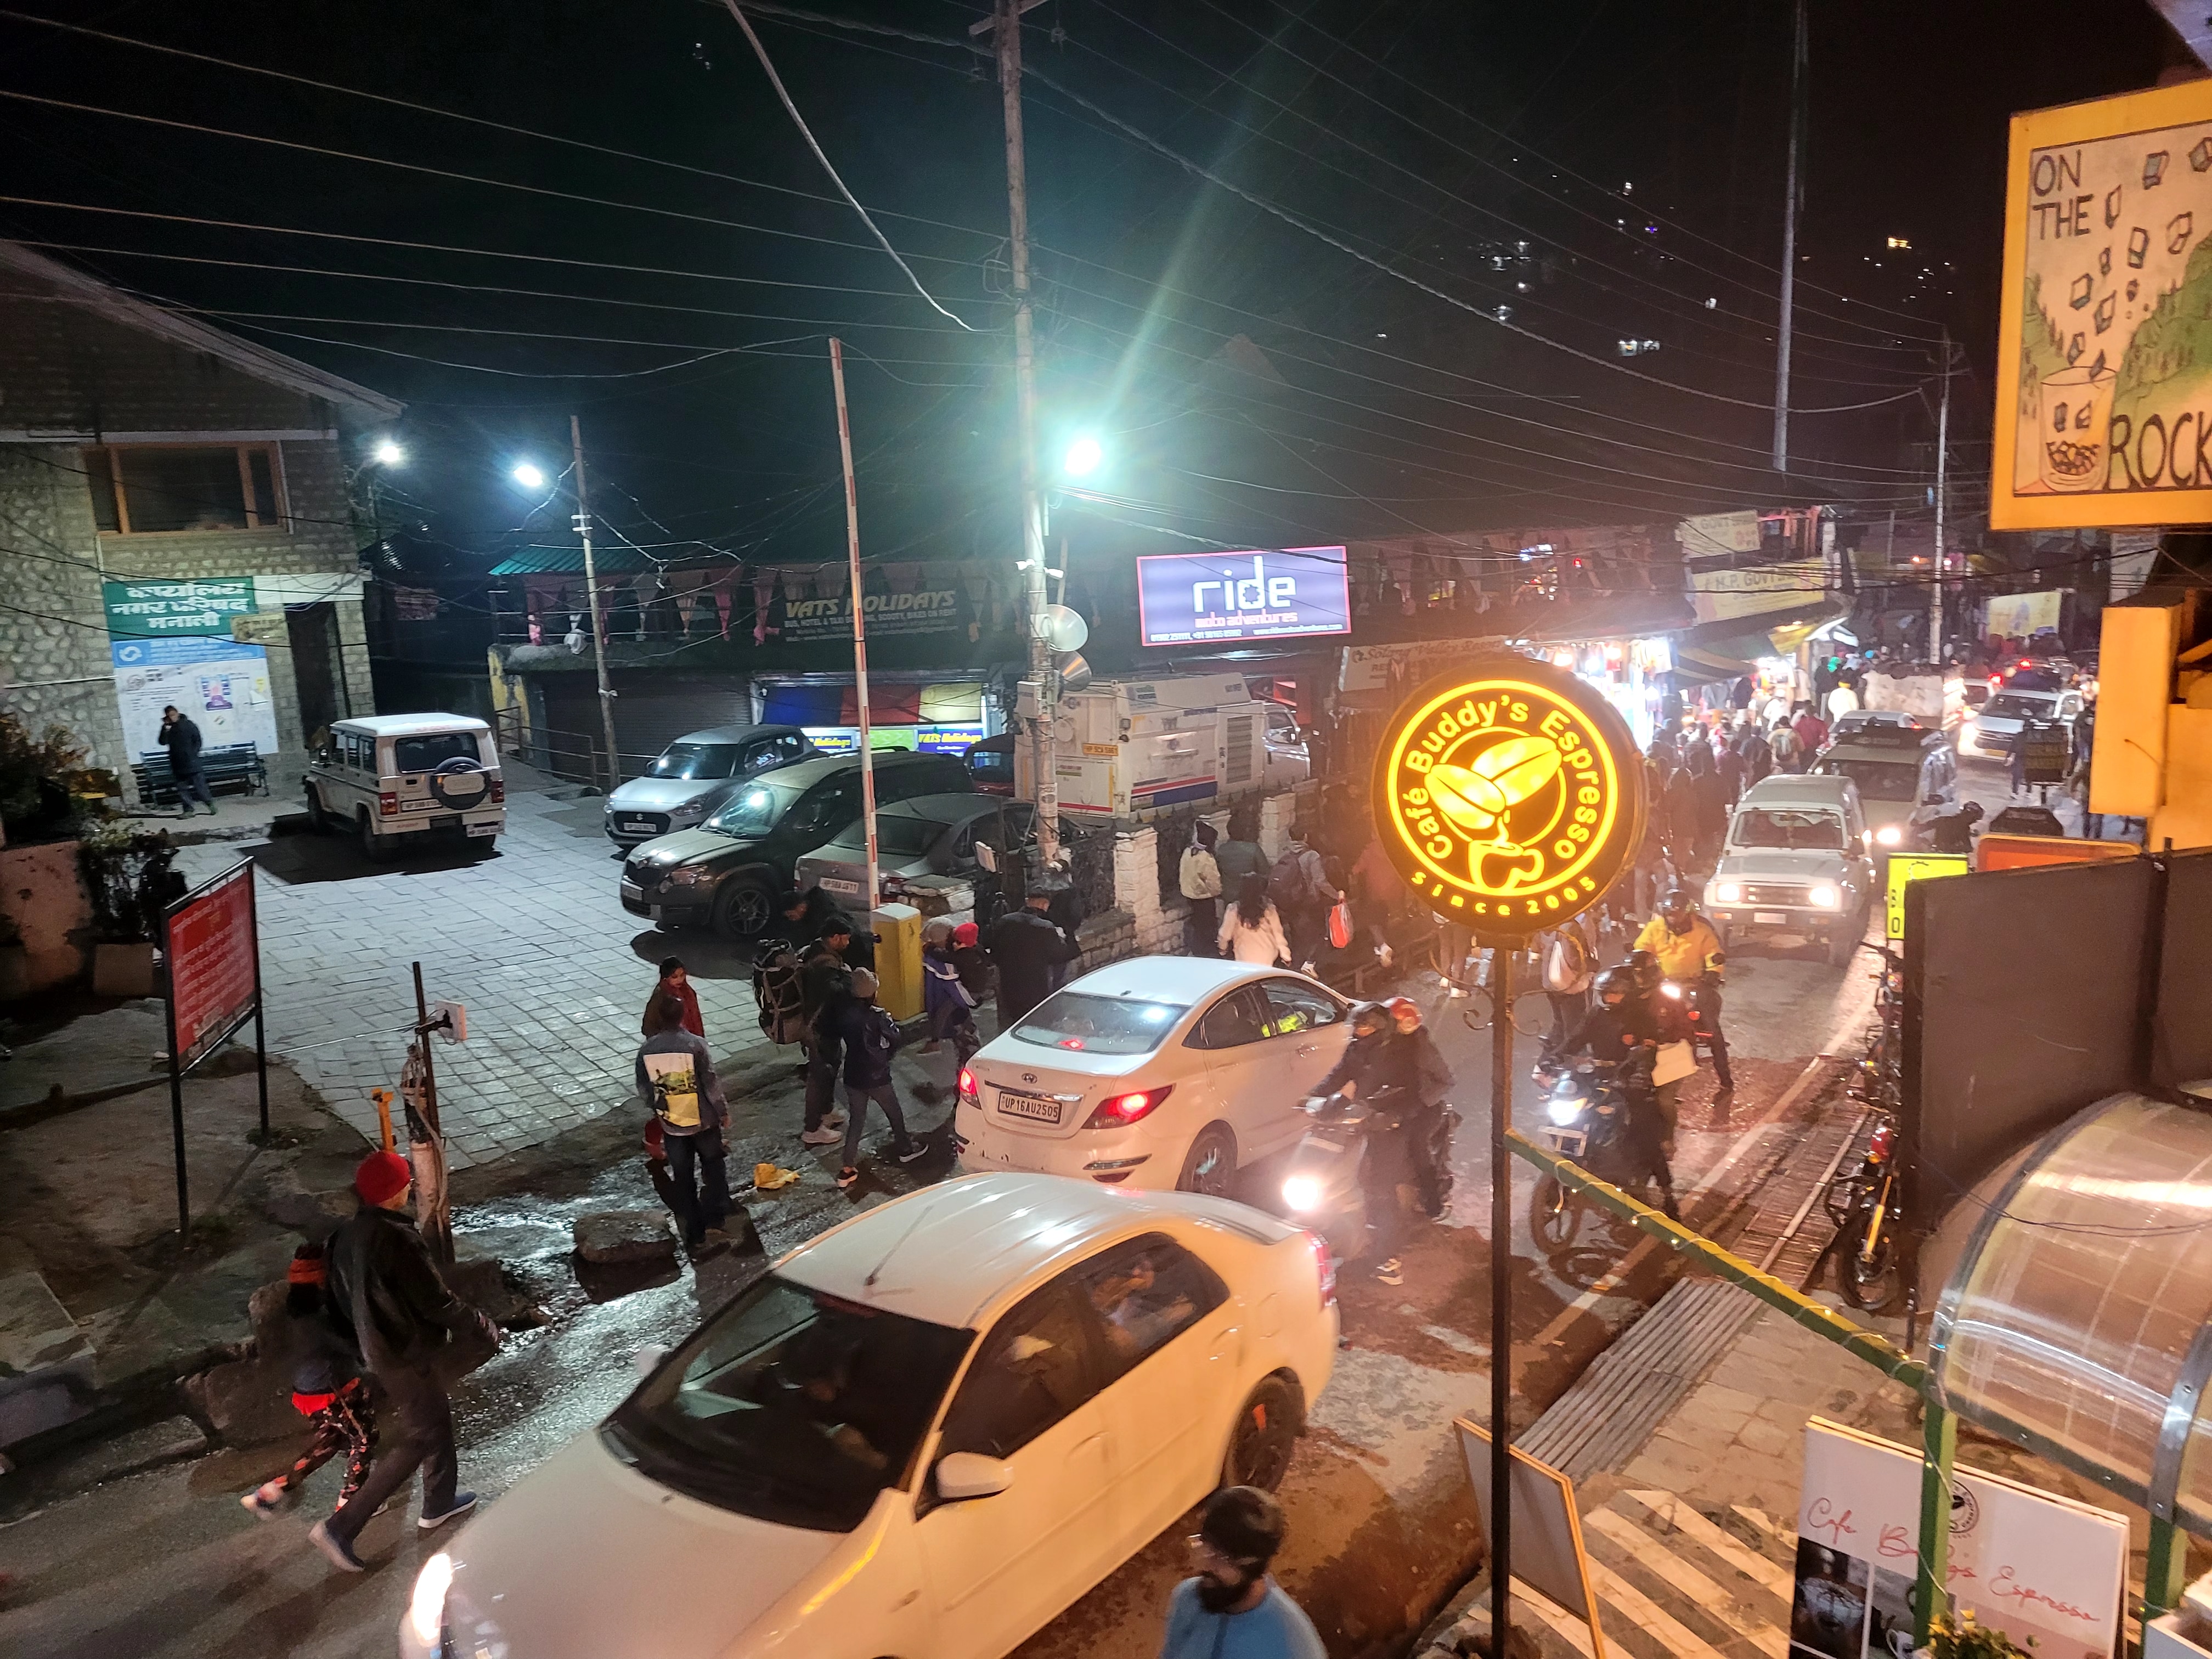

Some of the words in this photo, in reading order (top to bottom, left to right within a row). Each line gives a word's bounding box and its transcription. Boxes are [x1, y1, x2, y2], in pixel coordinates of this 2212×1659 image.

[2033, 150, 2083, 197] ON
[2033, 194, 2095, 240] THE
[1192, 555, 1296, 613] ride
[146, 612, 221, 628] मनाली
[786, 599, 839, 618] VATS
[1405, 695, 1530, 774] Buddy's
[1539, 709, 1601, 859] Espresso
[1402, 787, 1453, 859] Café
[1525, 876, 1598, 915] 2005
